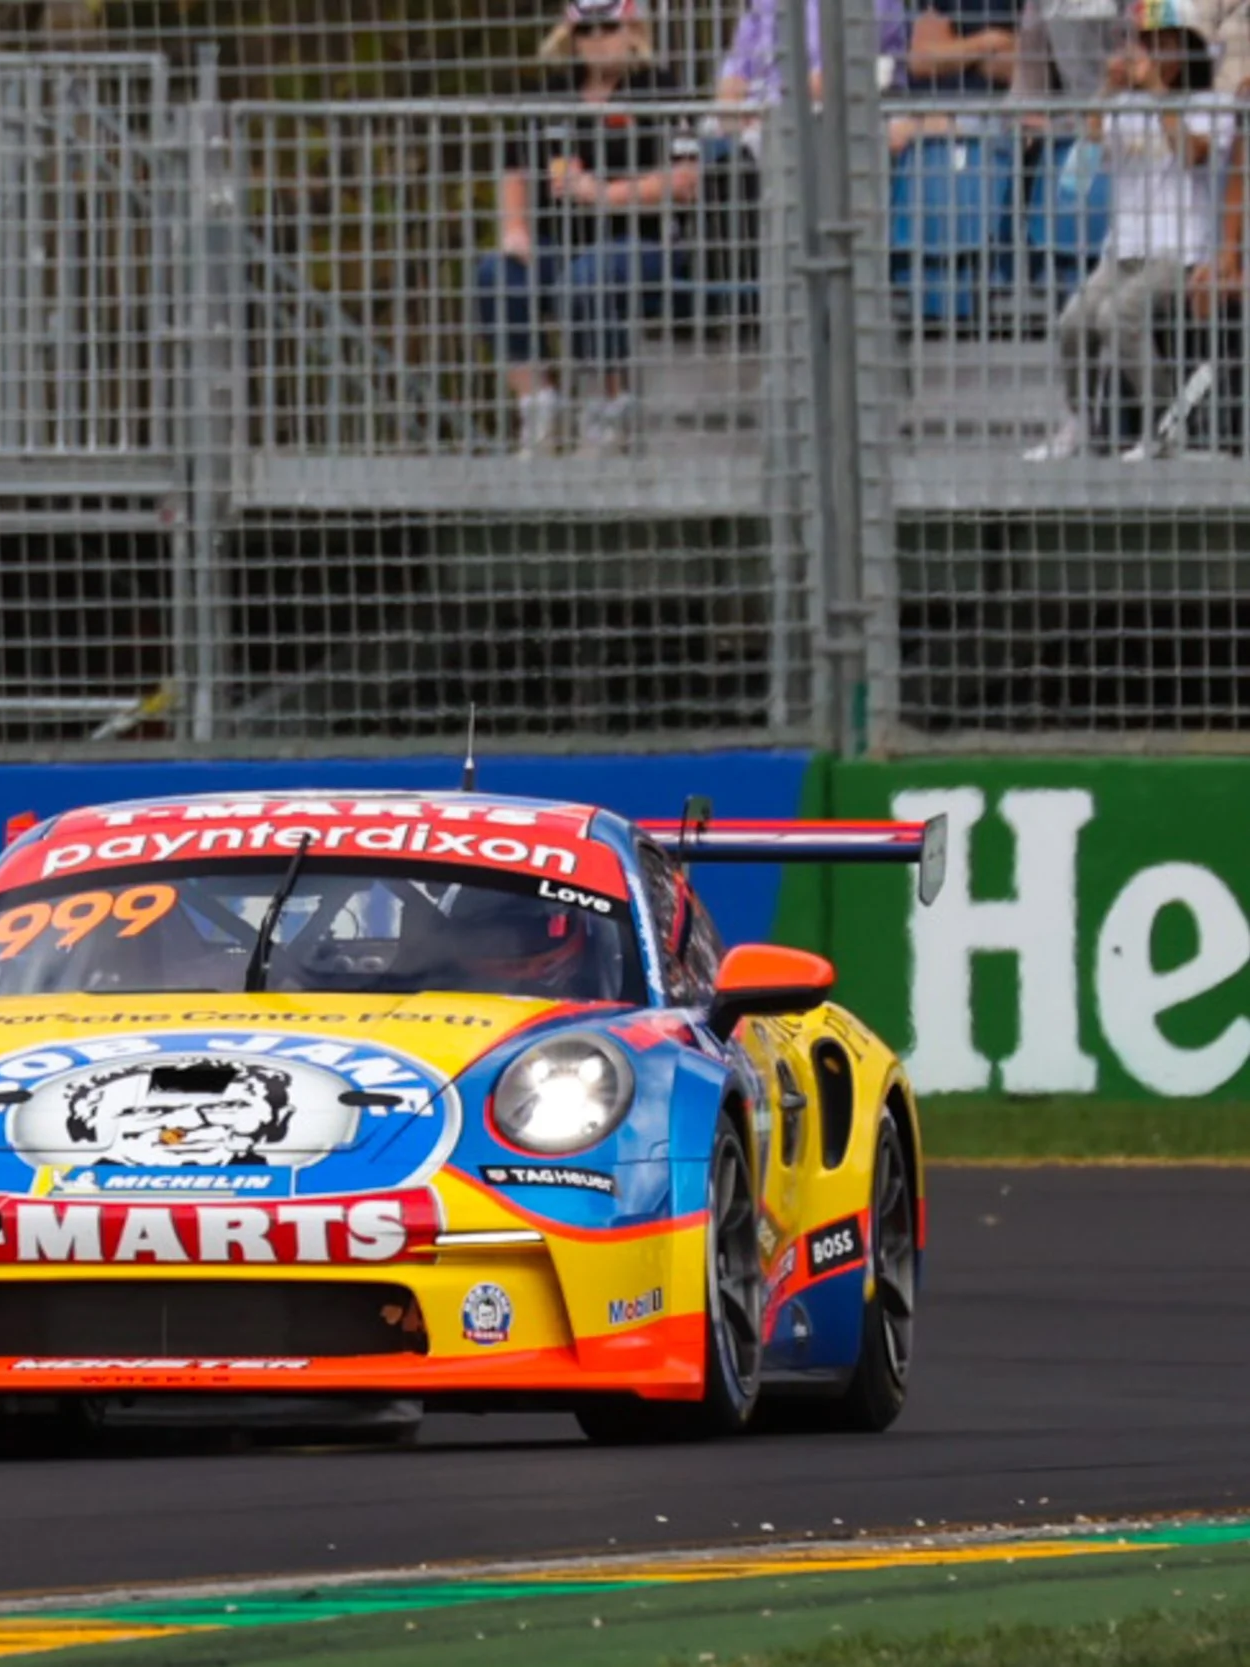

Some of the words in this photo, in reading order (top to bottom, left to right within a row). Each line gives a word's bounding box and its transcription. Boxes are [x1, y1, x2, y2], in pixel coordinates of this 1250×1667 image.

[101, 801, 537, 826] T-MARTS
[40, 821, 577, 879] paynterdixon
[538, 880, 612, 913] Love
[891, 786, 1250, 1098] He
[181, 1010, 347, 1023] Centre
[357, 1012, 492, 1028] Perth
[103, 1175, 272, 1189] MICHELIN
[812, 1228, 855, 1265] BOSS
